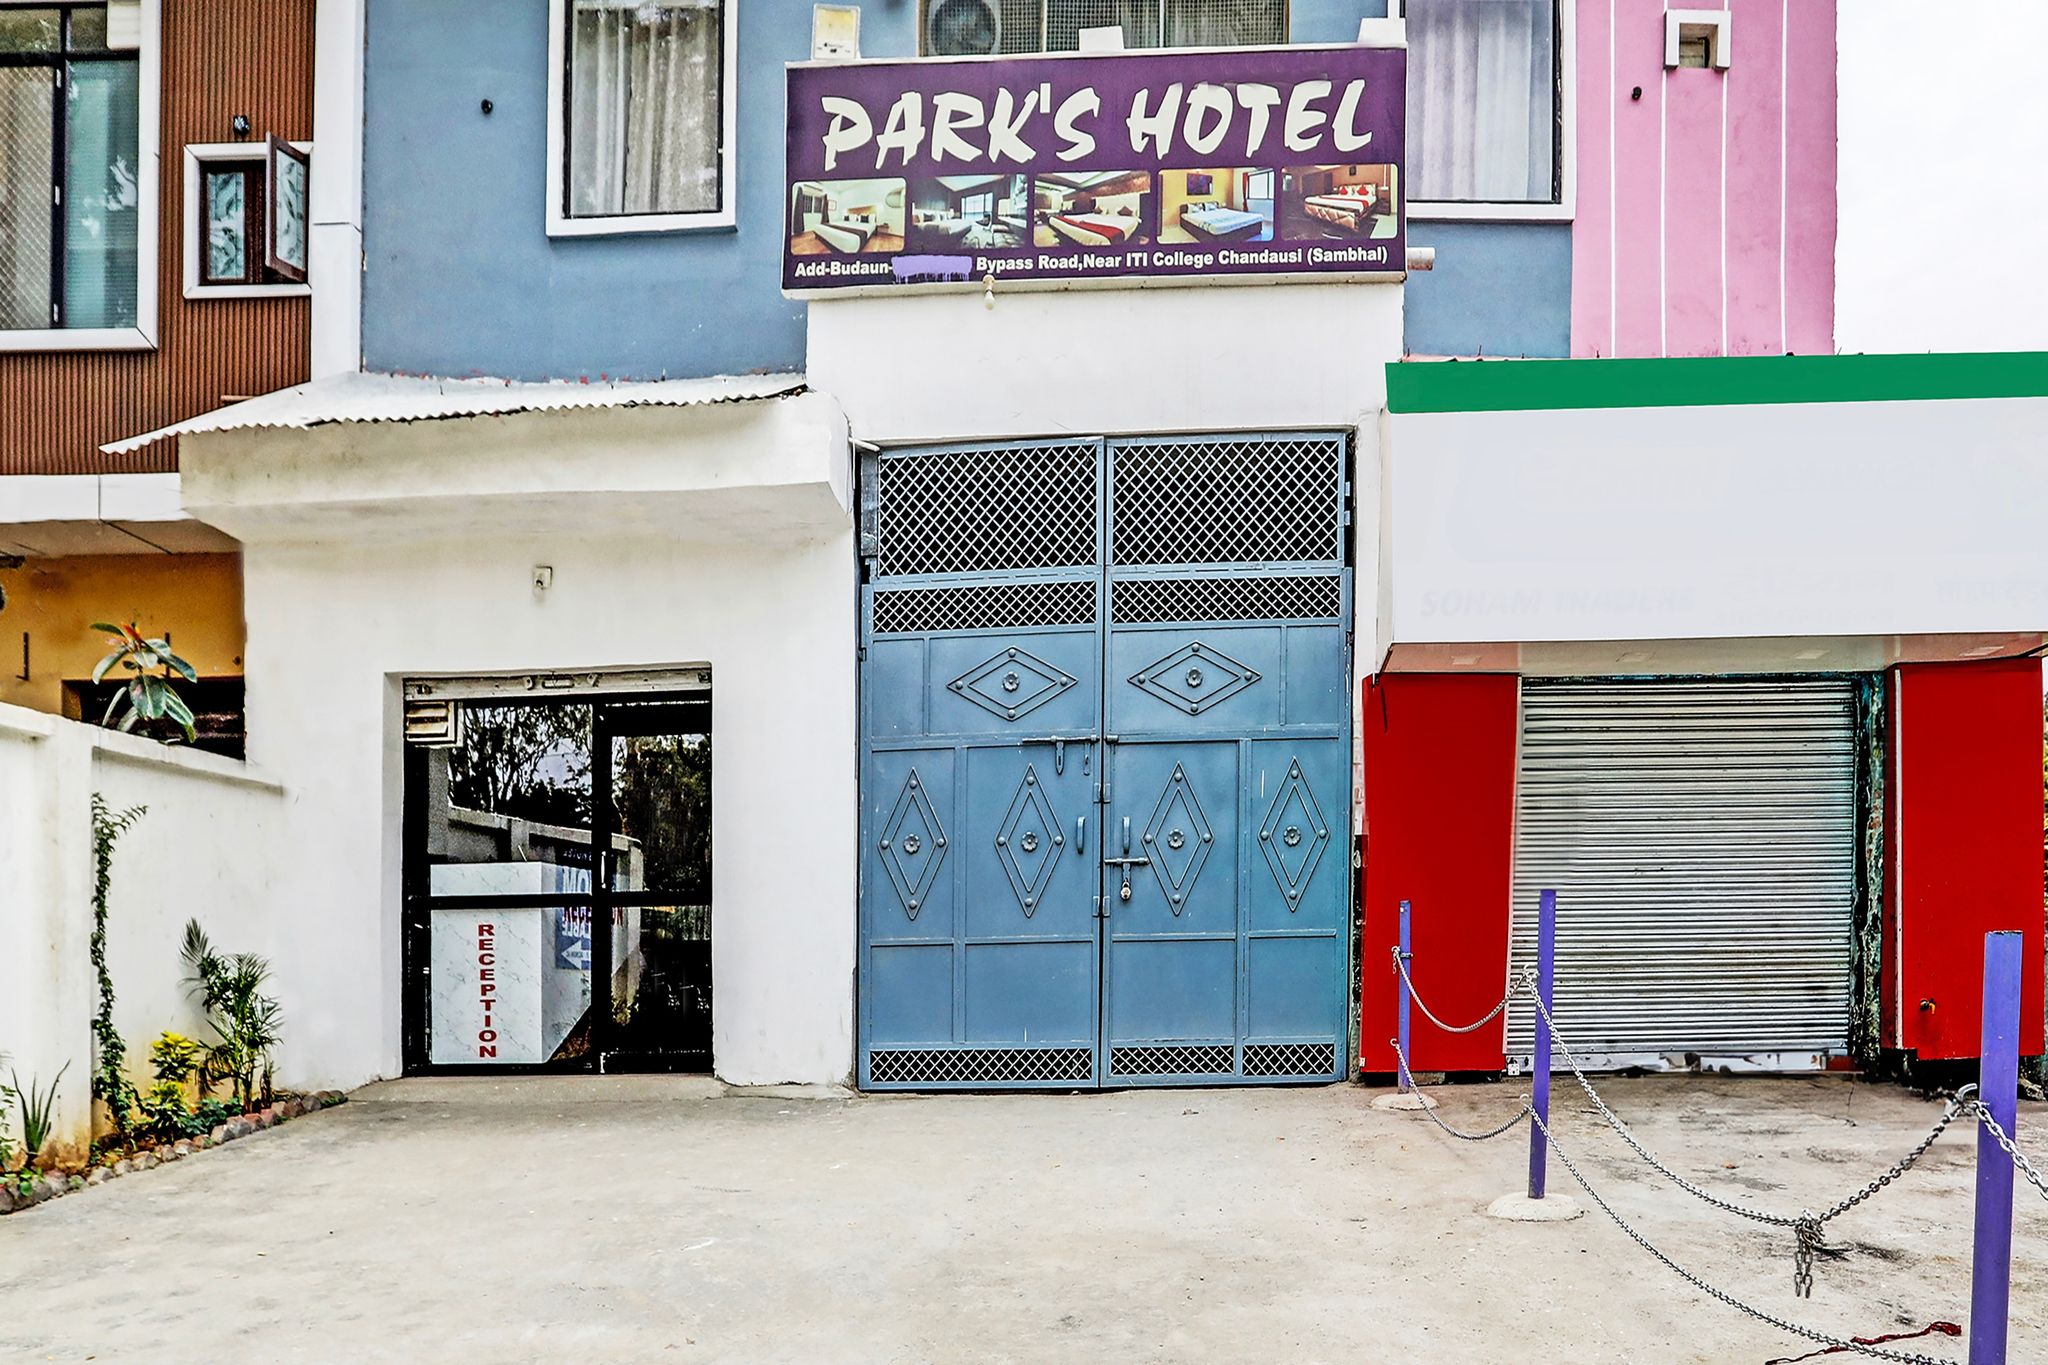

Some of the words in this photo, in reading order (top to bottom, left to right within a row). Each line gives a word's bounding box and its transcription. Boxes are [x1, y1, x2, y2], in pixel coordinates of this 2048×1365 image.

[821, 82, 1100, 171] PARK'S
[1125, 79, 1373, 160] HOTEL
[976, 256, 1034, 274] Bypass
[1126, 252, 1148, 267] ITI
[1152, 251, 1214, 269] College
[1218, 248, 1302, 265] Chandausi
[1307, 246, 1388, 266] (Sambhal)
[477, 923, 498, 1059] RECEPTION
